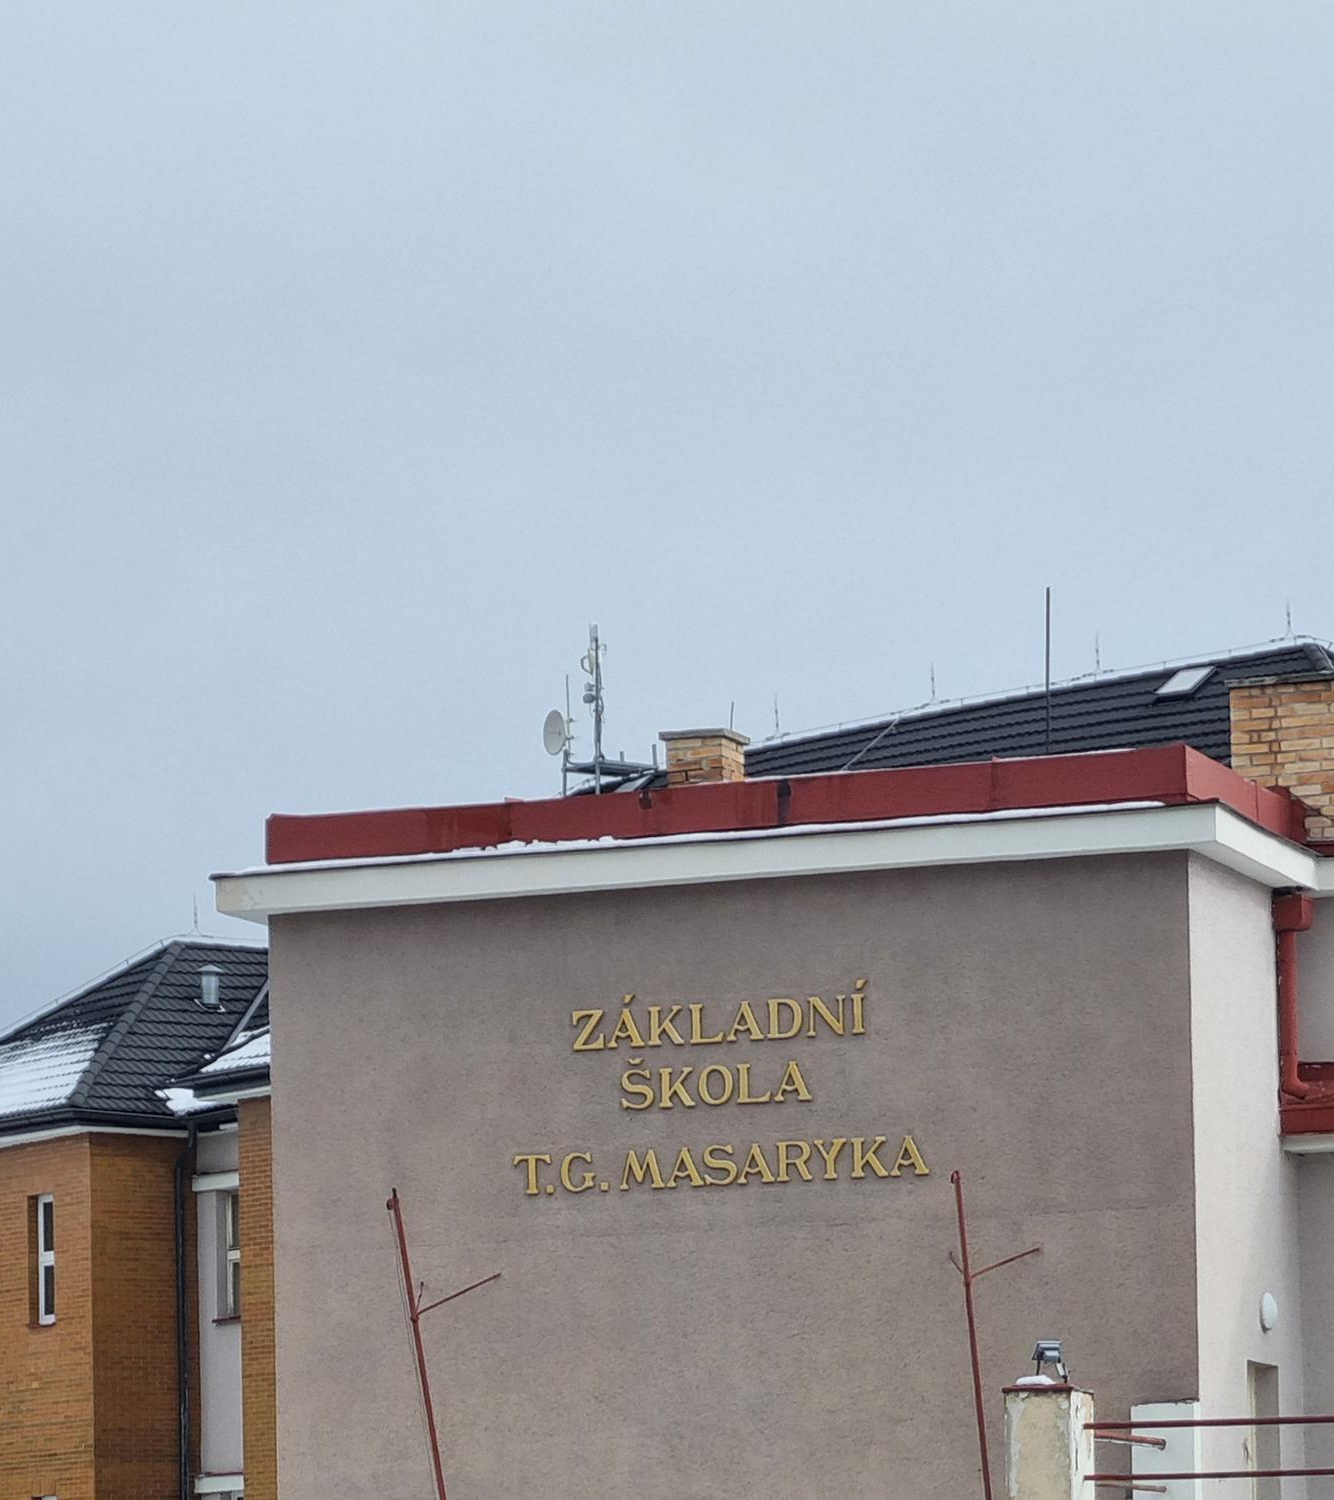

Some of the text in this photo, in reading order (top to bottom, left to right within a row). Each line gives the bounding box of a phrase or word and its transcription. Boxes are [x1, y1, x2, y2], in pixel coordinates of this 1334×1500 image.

[571, 979, 869, 1052] ZÁKLADNÍ
[620, 1057, 813, 1111] ŠKOLA
[620, 1134, 931, 1192] MASARYKA
